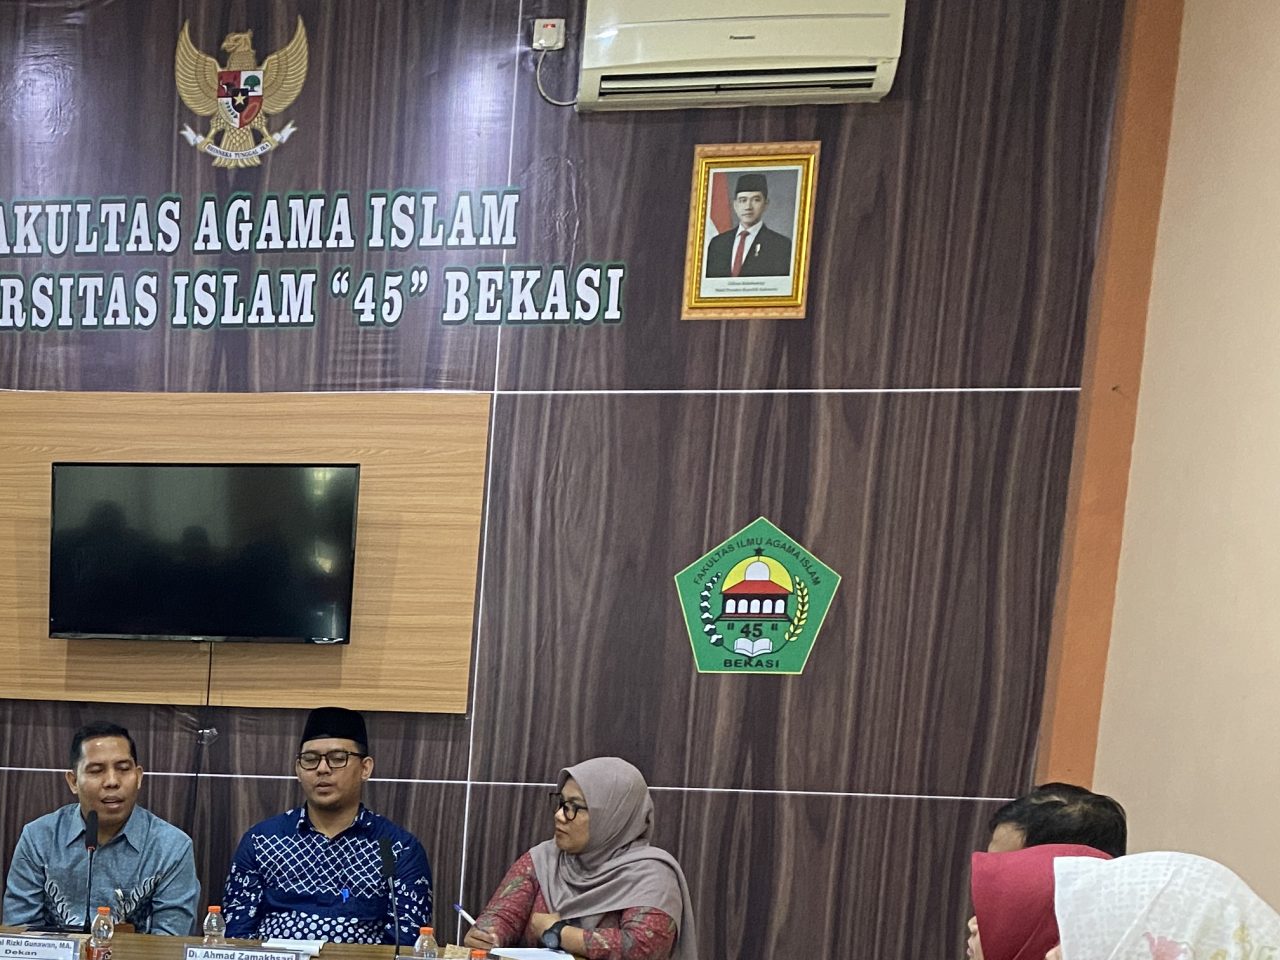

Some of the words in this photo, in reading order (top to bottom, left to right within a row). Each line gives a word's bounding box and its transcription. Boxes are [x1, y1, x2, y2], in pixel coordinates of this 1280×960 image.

[193, 197, 355, 252] AGAMA
[370, 194, 519, 249] ISLAM
[171, 272, 316, 327] ISLAM
[442, 267, 625, 322] BEKASI
[694, 544, 736, 586] FAKULTAS
[736, 537, 763, 549] ILMU
[766, 538, 800, 560] AGAMA
[799, 557, 821, 586] ISLAM
[723, 658, 780, 669] BEKASI
[6, 939, 22, 947] Rizki
[203, 950, 235, 960] Ahmad
